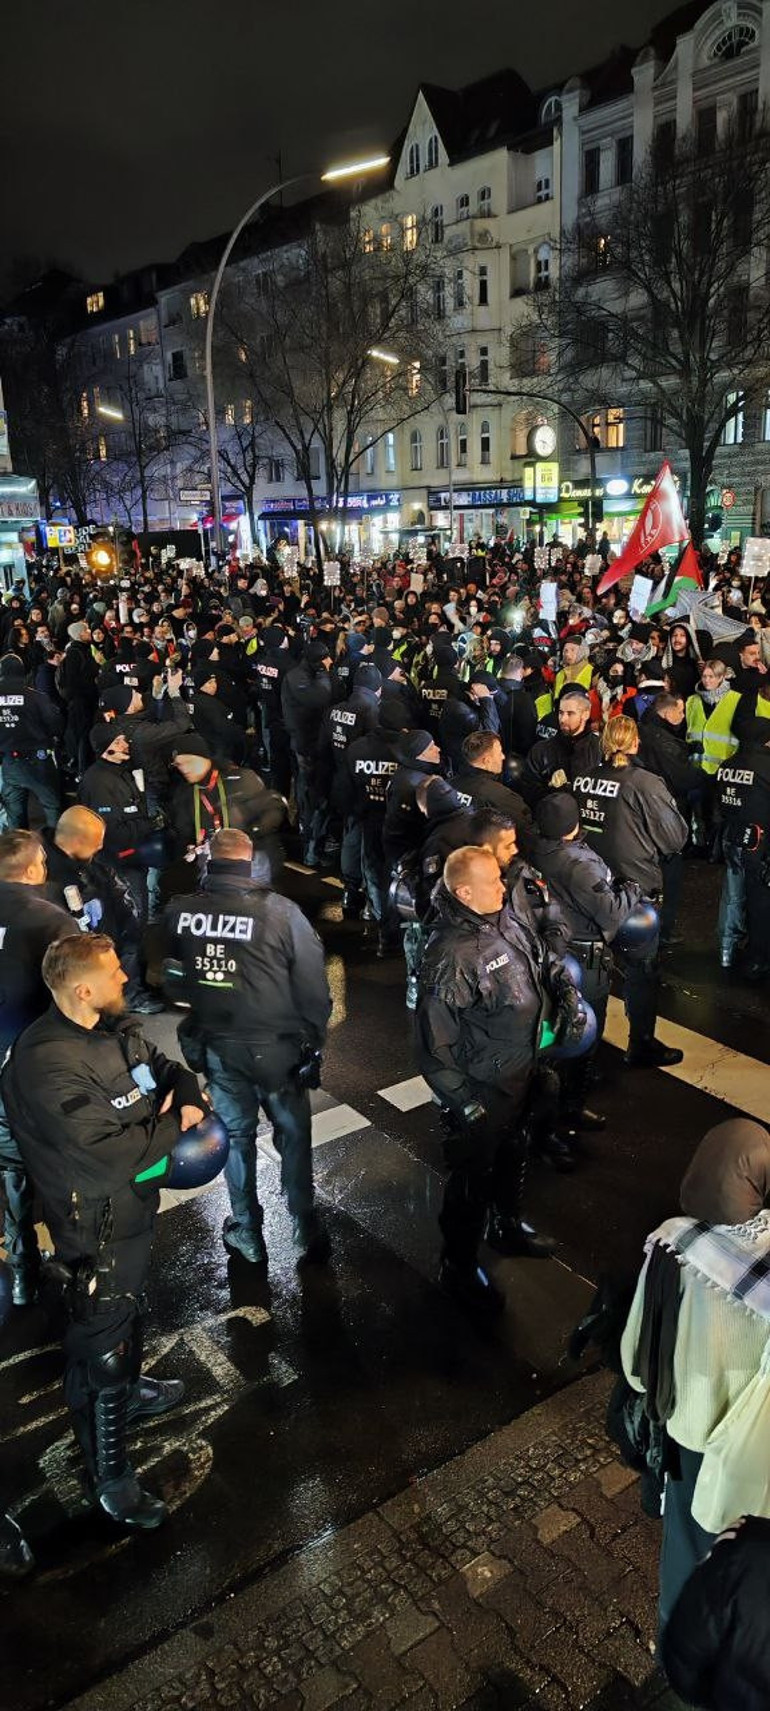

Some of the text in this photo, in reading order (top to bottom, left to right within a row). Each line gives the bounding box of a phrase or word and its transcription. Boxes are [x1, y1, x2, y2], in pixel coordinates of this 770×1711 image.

[330, 709, 356, 726] POLIZEI
[717, 768, 755, 785] POLIZEI
[573, 776, 620, 798] POLIZEI
[726, 787, 736, 796] BE
[586, 799, 599, 810] BE
[177, 912, 254, 941] POLIZEI
[206, 943, 225, 958] BE
[195, 956, 236, 972] 35110
